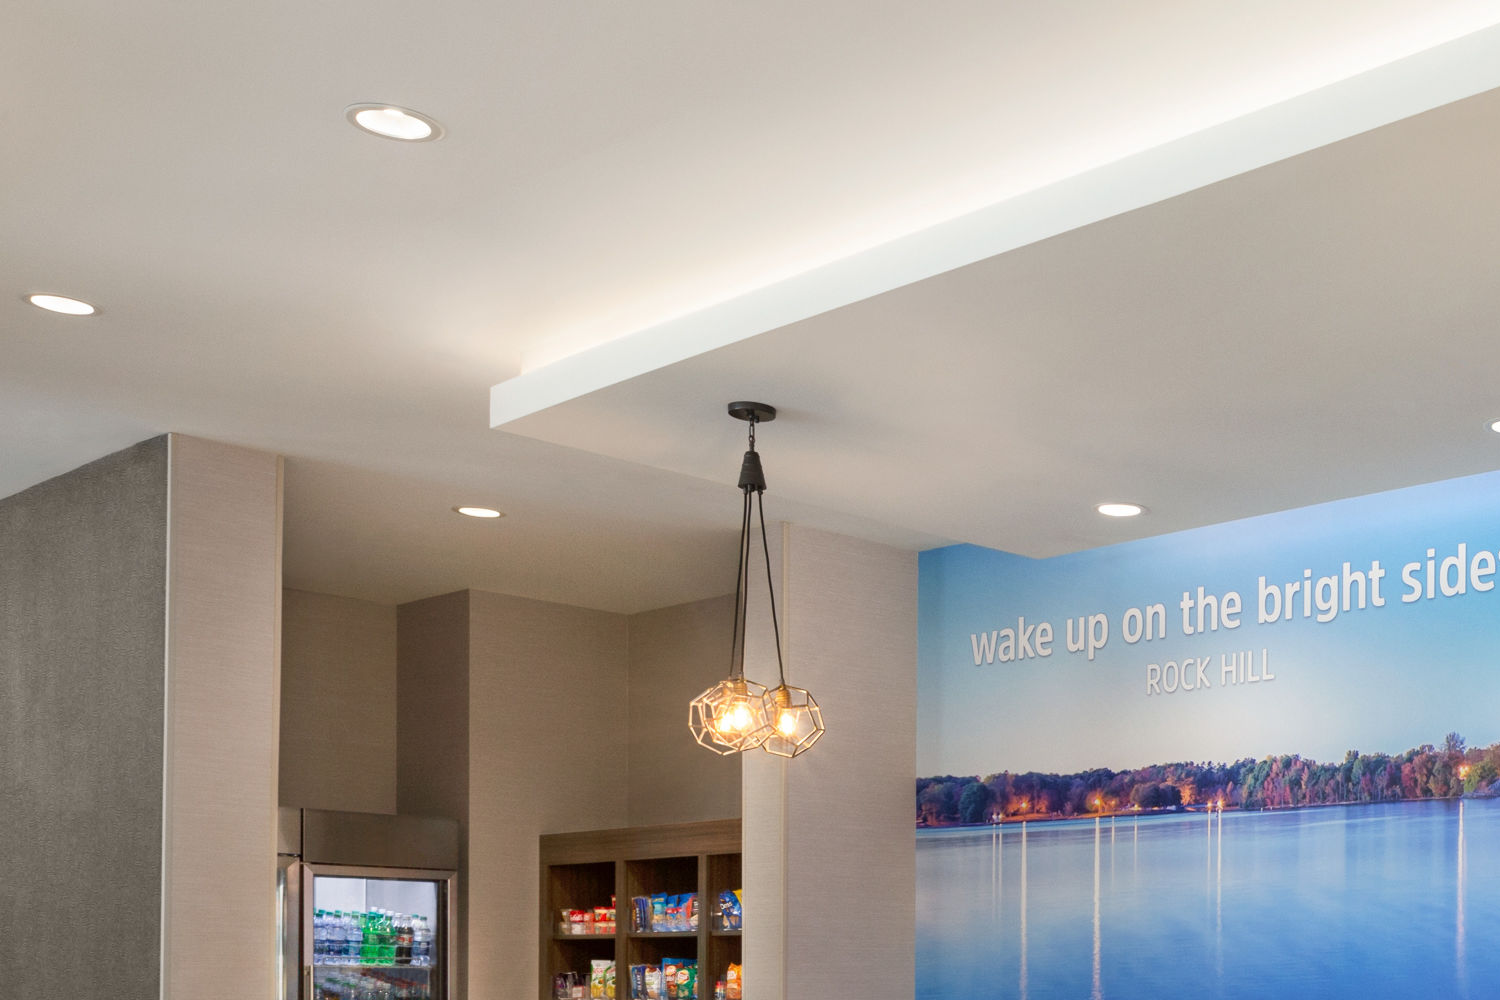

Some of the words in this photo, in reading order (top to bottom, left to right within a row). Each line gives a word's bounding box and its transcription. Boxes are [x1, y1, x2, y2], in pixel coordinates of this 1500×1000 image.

[971, 616, 1053, 665] wake
[1065, 610, 1109, 660] up
[1122, 603, 1166, 643] on
[1180, 586, 1241, 636] the
[1257, 560, 1386, 624] bright
[1146, 656, 1211, 696] ROCK
[1220, 648, 1275, 686] HILL
